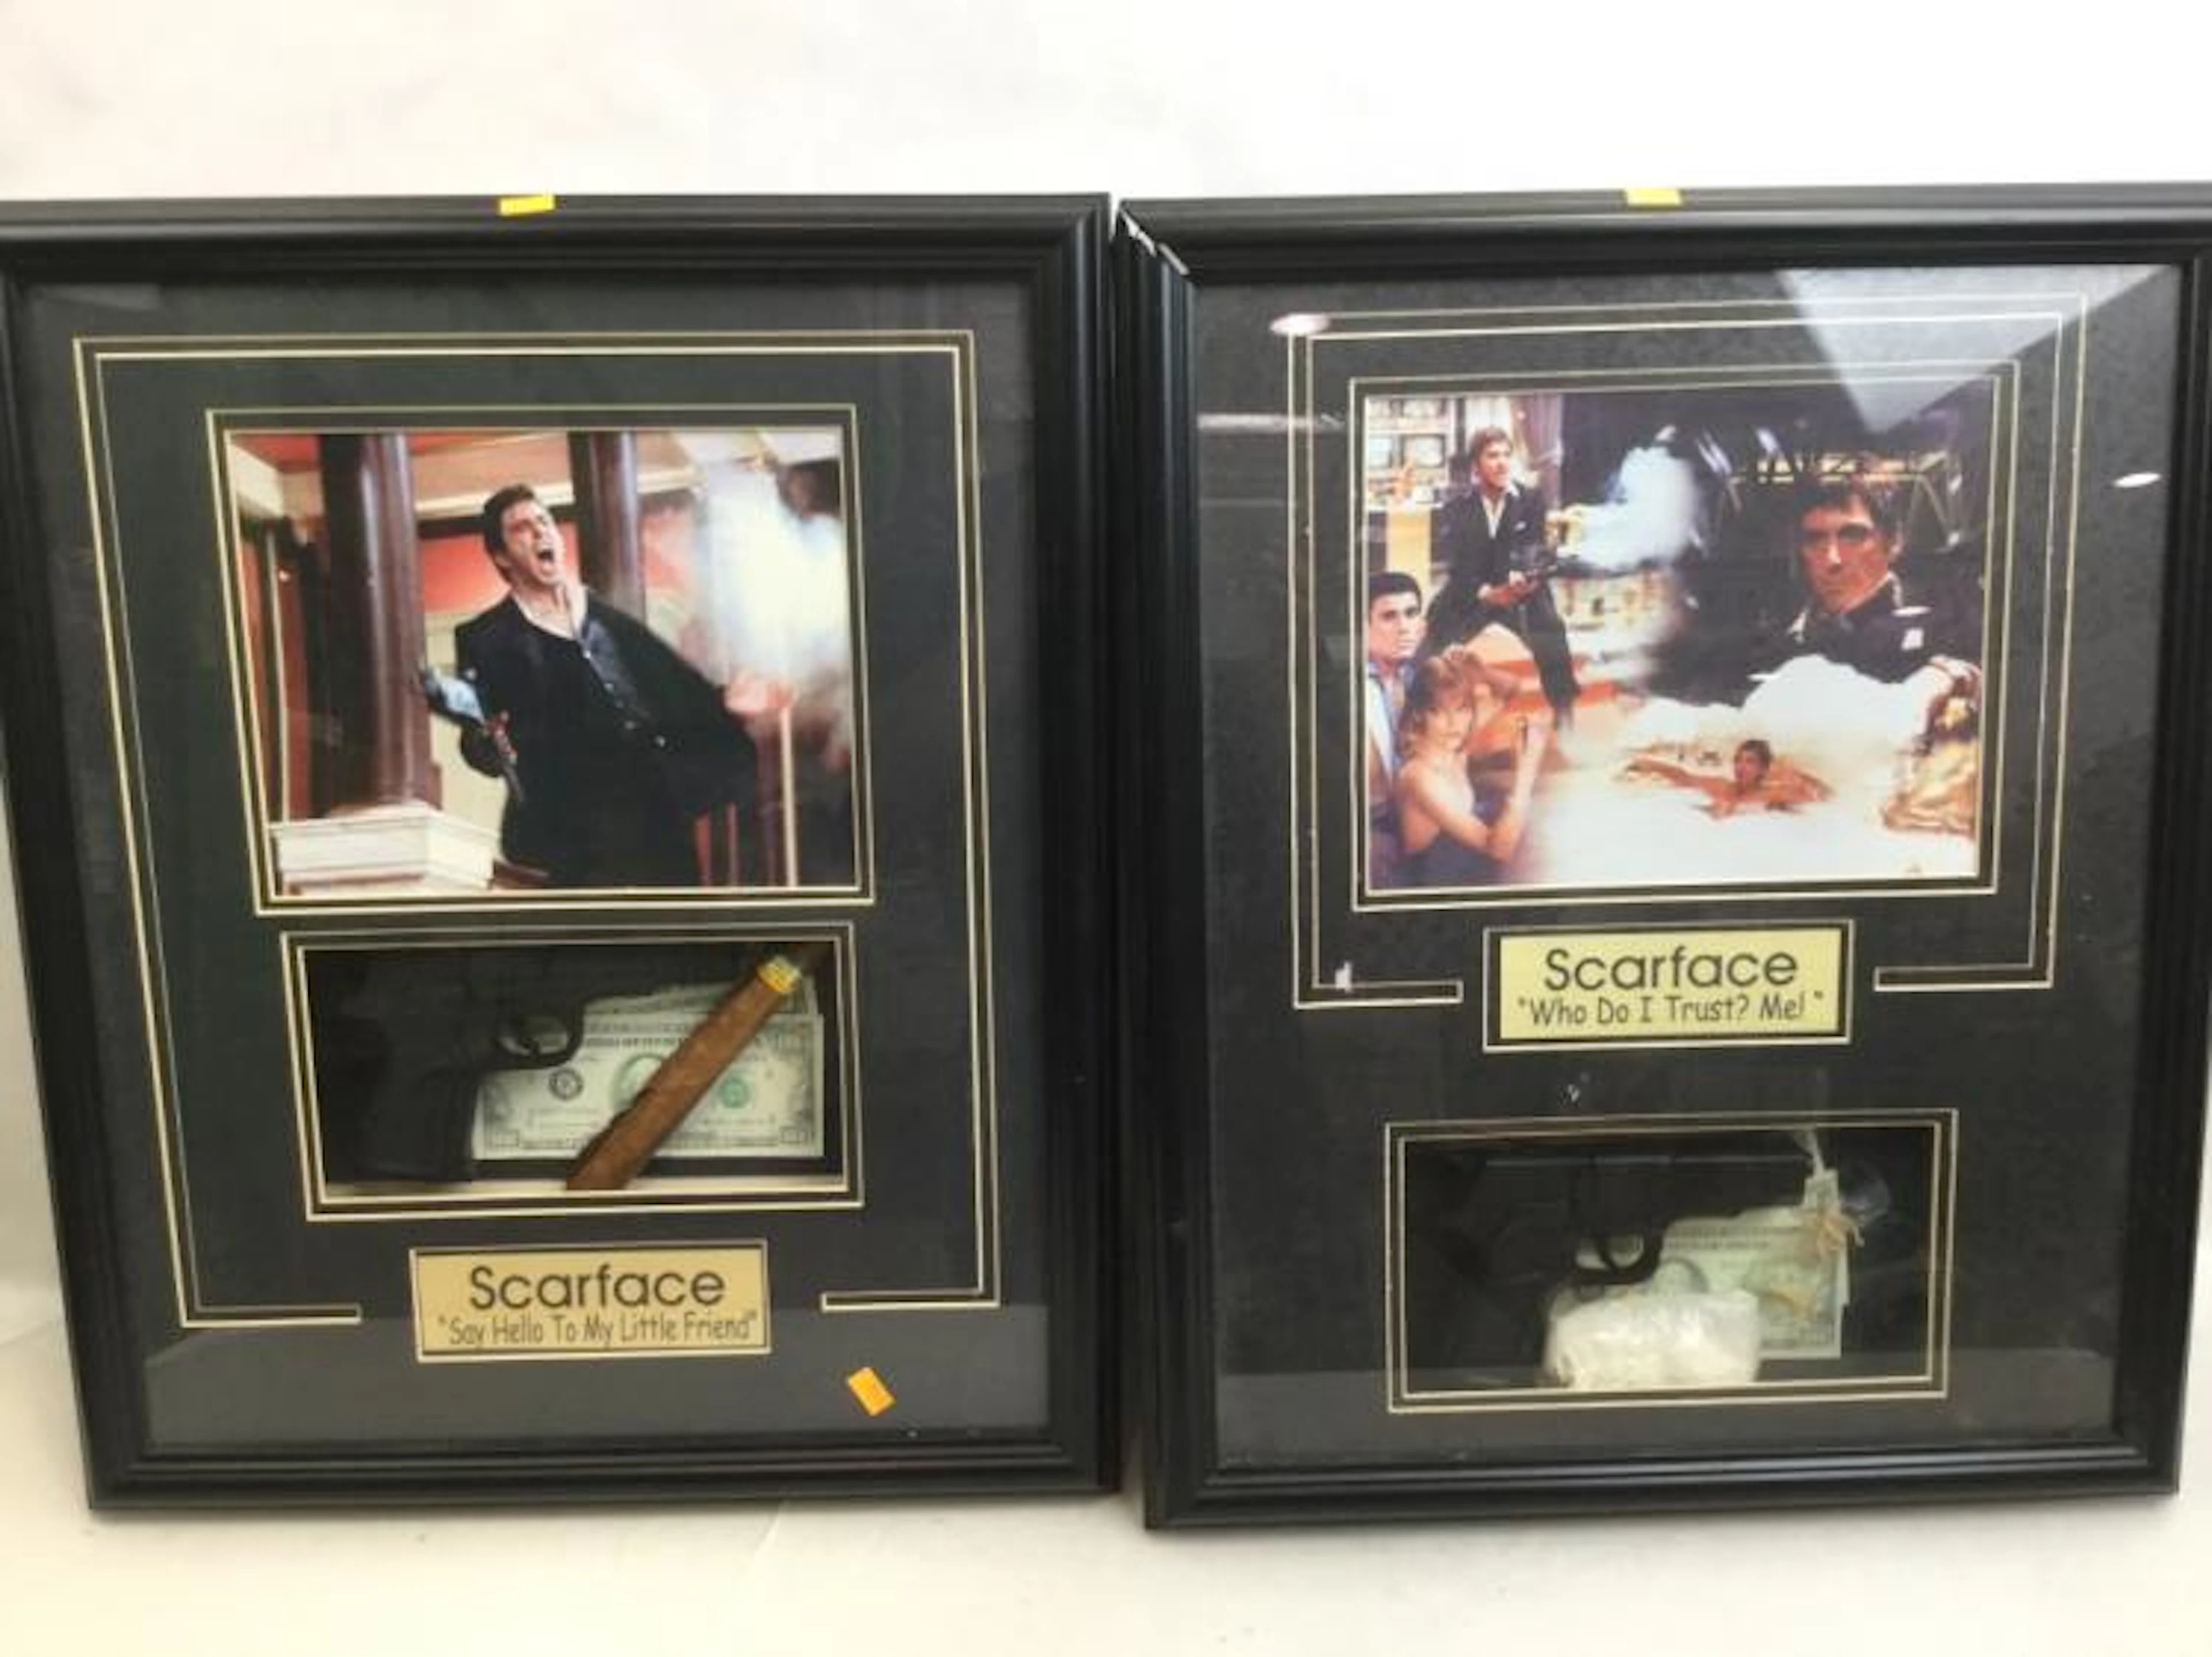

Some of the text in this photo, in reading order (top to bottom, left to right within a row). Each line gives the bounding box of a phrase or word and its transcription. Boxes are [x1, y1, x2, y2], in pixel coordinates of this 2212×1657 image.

[1544, 946, 1798, 991] Scarface
[1517, 996, 1587, 1026] "Who
[1597, 996, 1629, 1025] Do
[1641, 996, 1653, 1023] I
[1665, 993, 1749, 1021] Trust?
[469, 1263, 726, 1310] Scarface
[438, 1309, 758, 1351] "Say Hello To My Little Friend"
